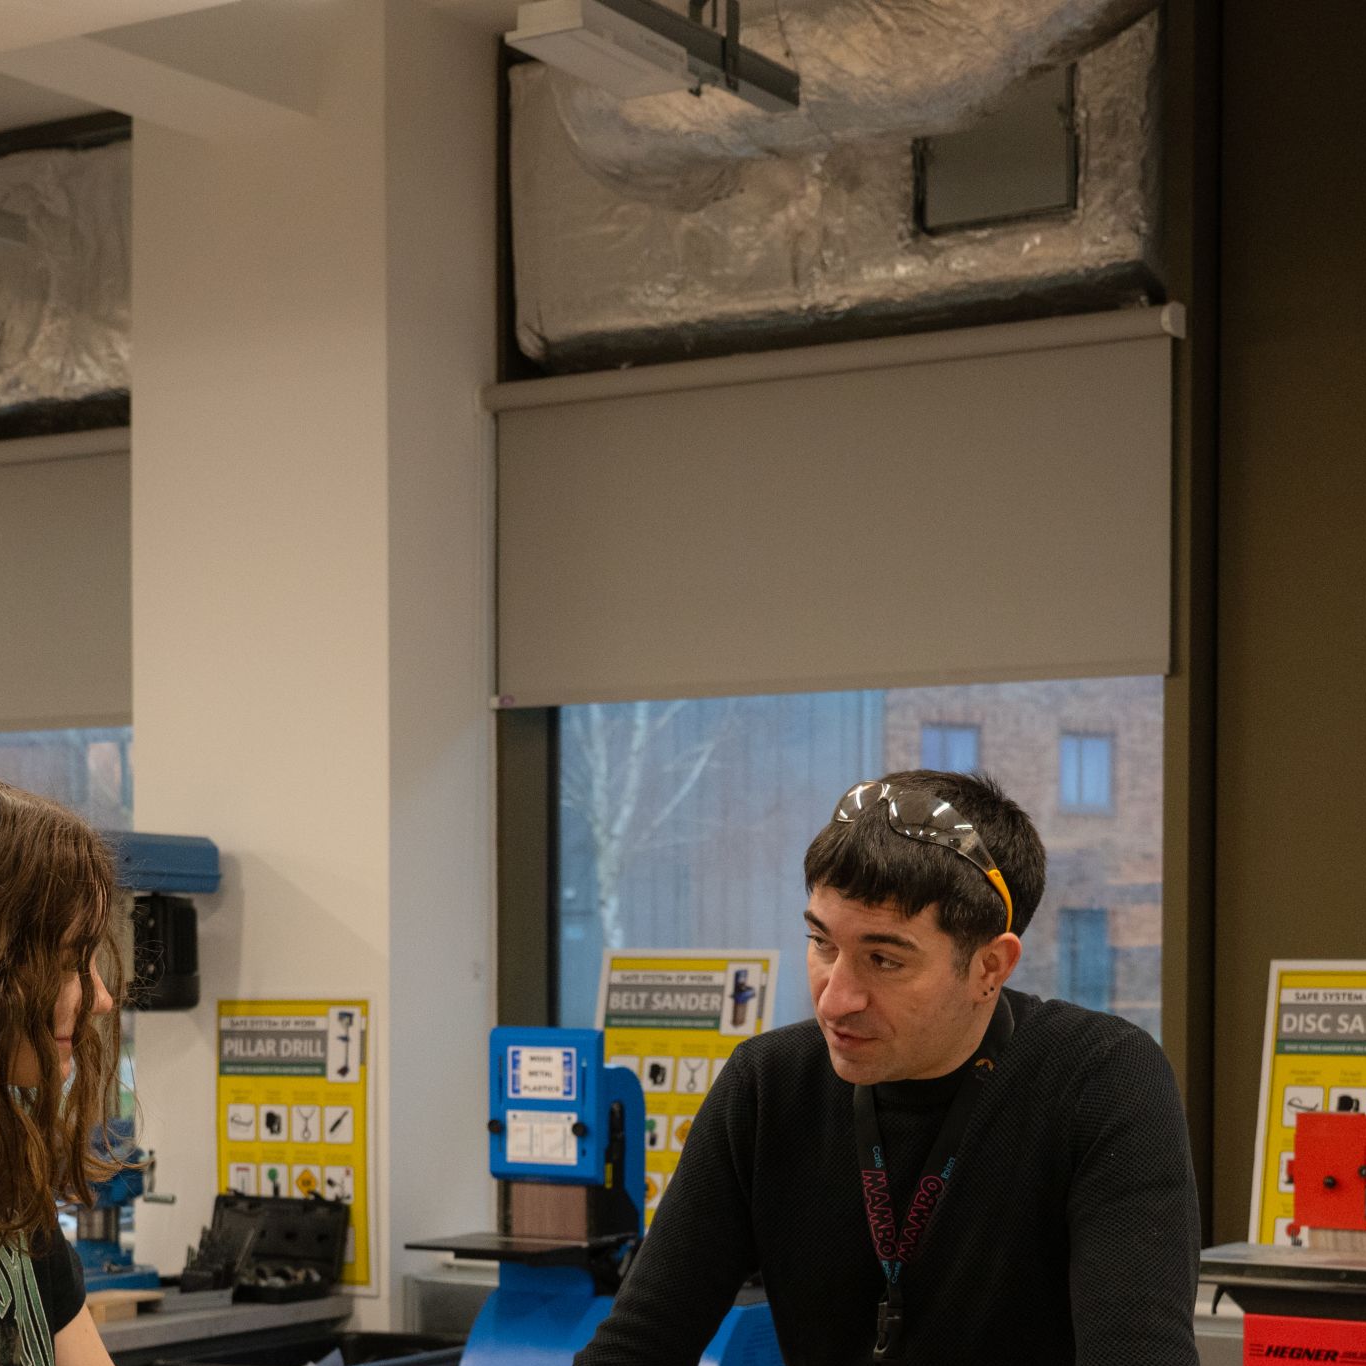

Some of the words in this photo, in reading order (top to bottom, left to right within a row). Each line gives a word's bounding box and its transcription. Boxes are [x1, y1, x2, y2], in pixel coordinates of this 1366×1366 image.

[609, 992, 651, 1010] BELT
[652, 993, 722, 1011] SANDER
[1295, 992, 1318, 1001] SAFE
[1322, 992, 1363, 1001] SYSTEM
[1281, 1013, 1332, 1034] DISC
[223, 1038, 277, 1057] PILLAR
[280, 1039, 325, 1058] DRILL
[861, 1169, 898, 1260] MAMBO
[897, 1175, 945, 1262] MAMBO
[1264, 1344, 1339, 1362] HEGNER
